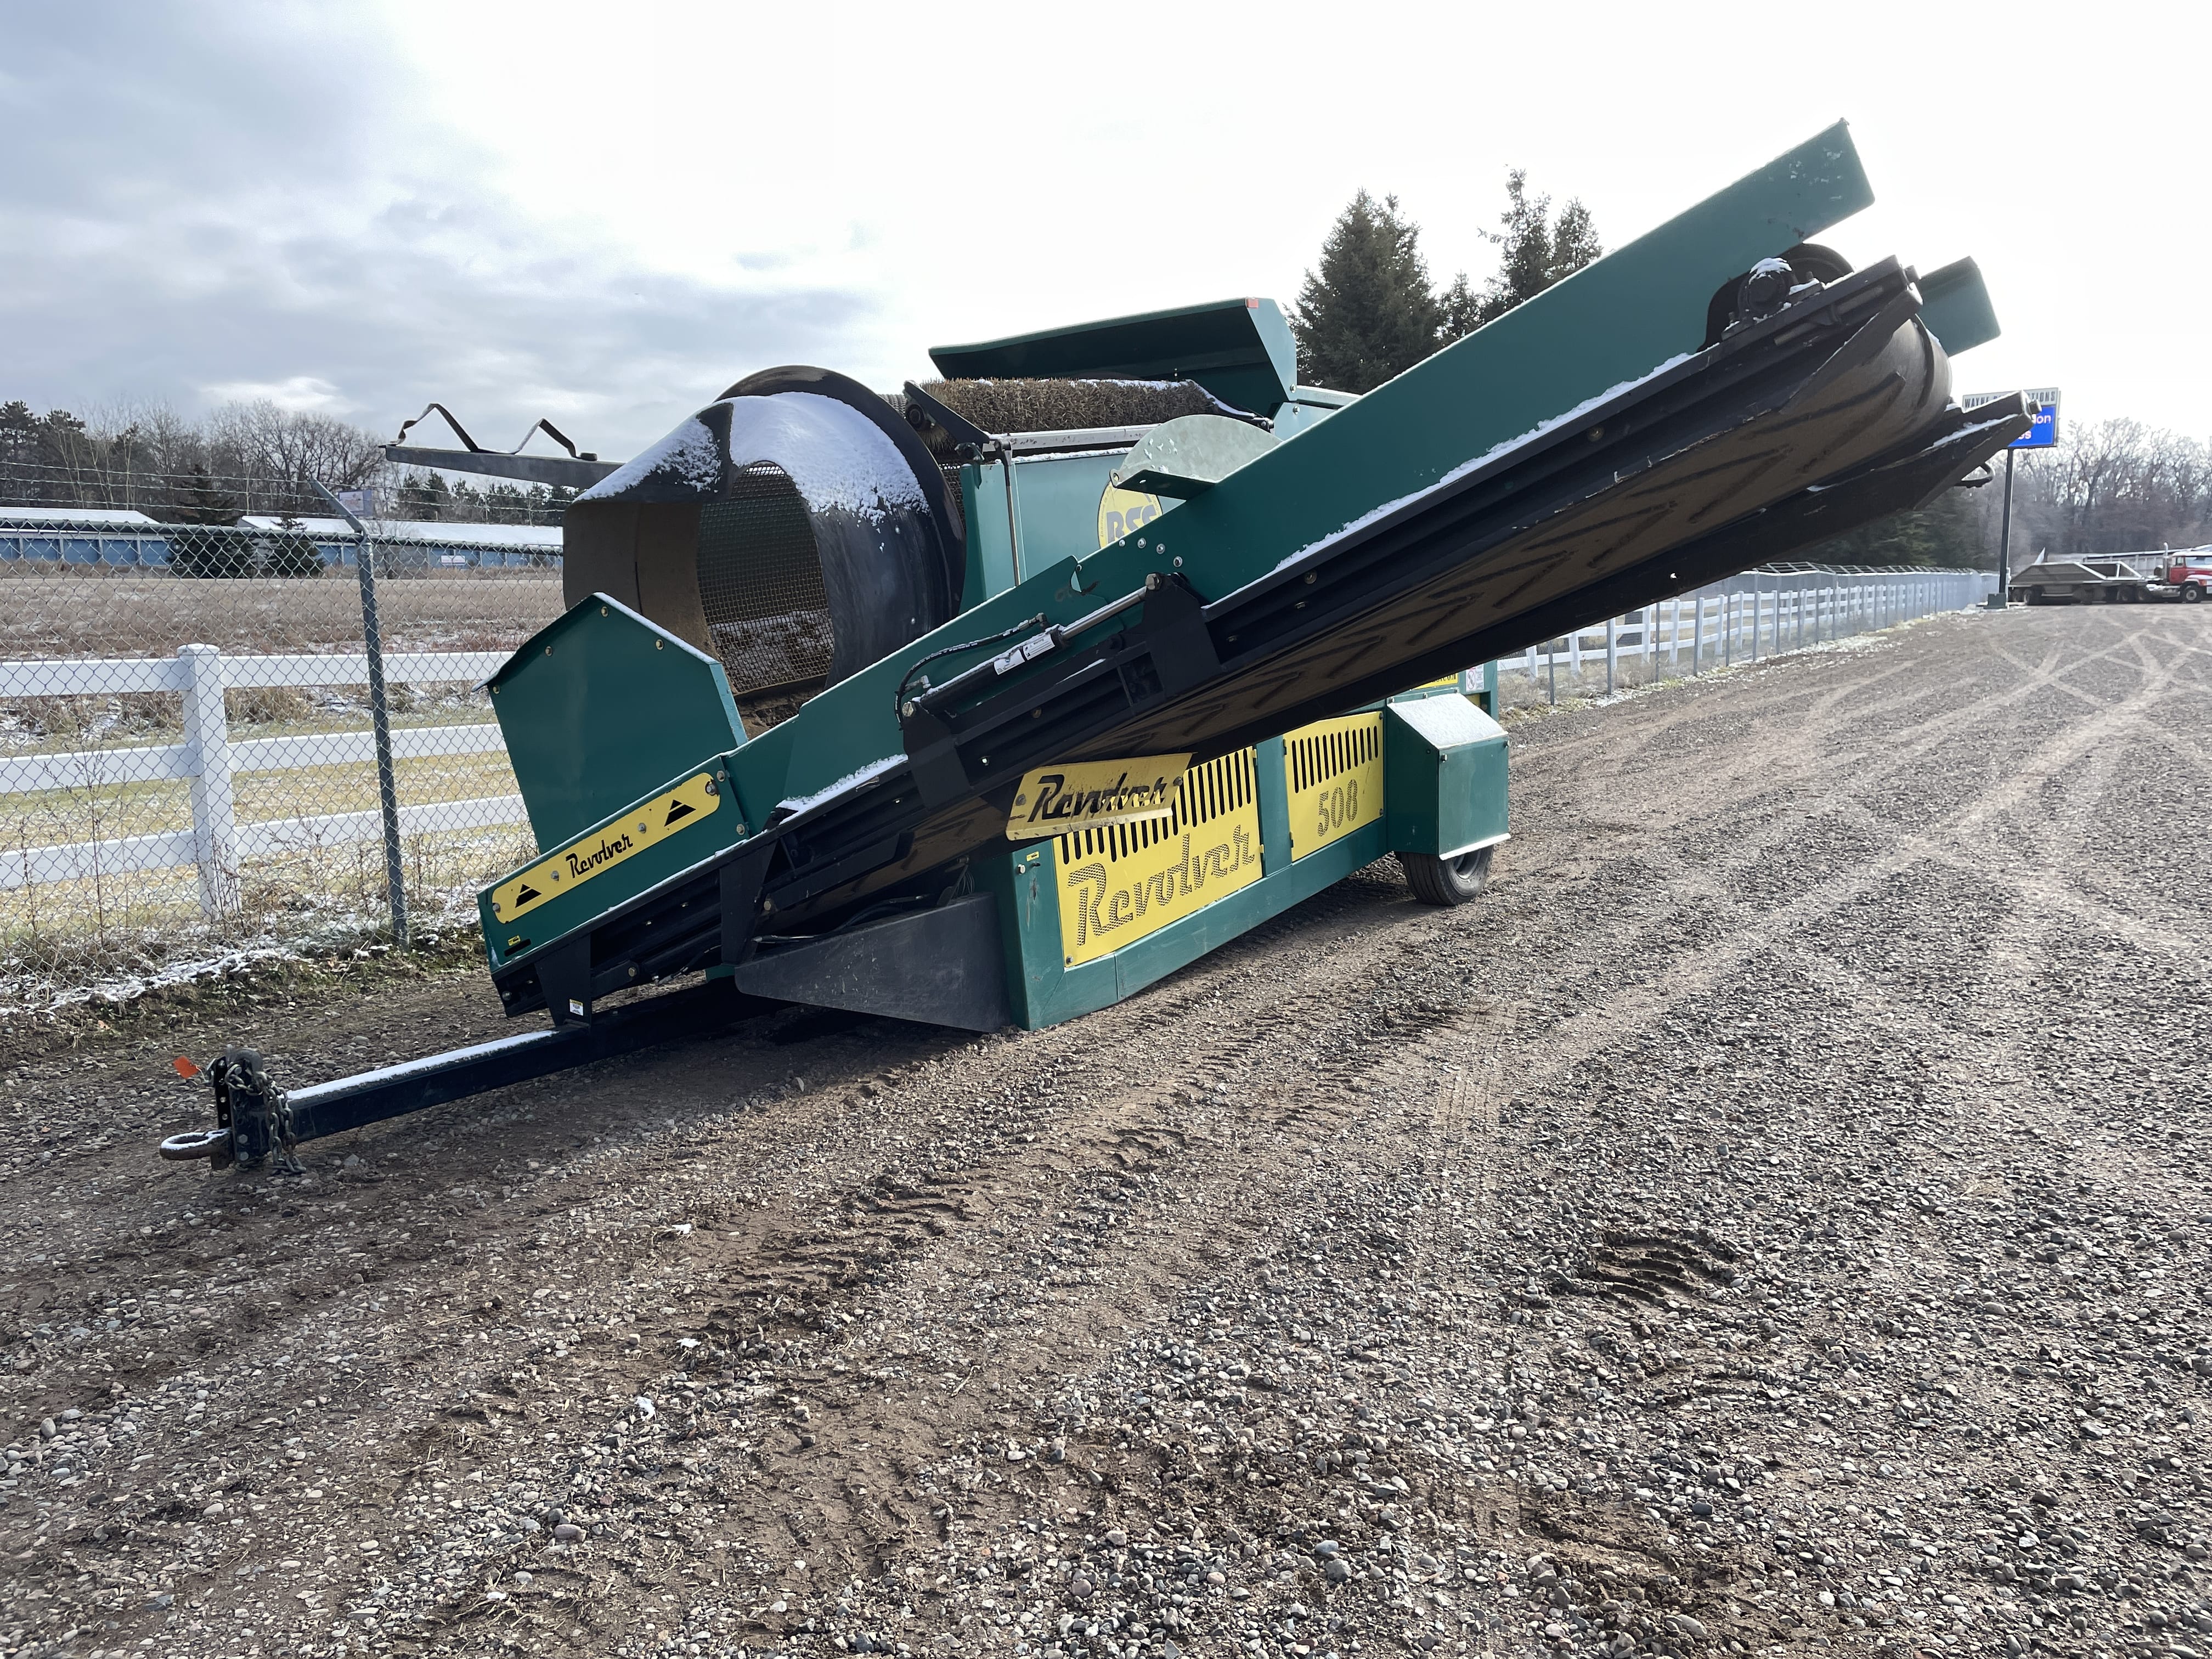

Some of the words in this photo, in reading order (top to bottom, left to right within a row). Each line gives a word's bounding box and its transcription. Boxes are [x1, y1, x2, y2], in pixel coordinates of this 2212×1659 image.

[1028, 772, 1167, 822] Revolver
[1317, 779, 1358, 837] 508
[566, 833, 634, 878] Revolver
[1067, 824, 1255, 947] Revolver
